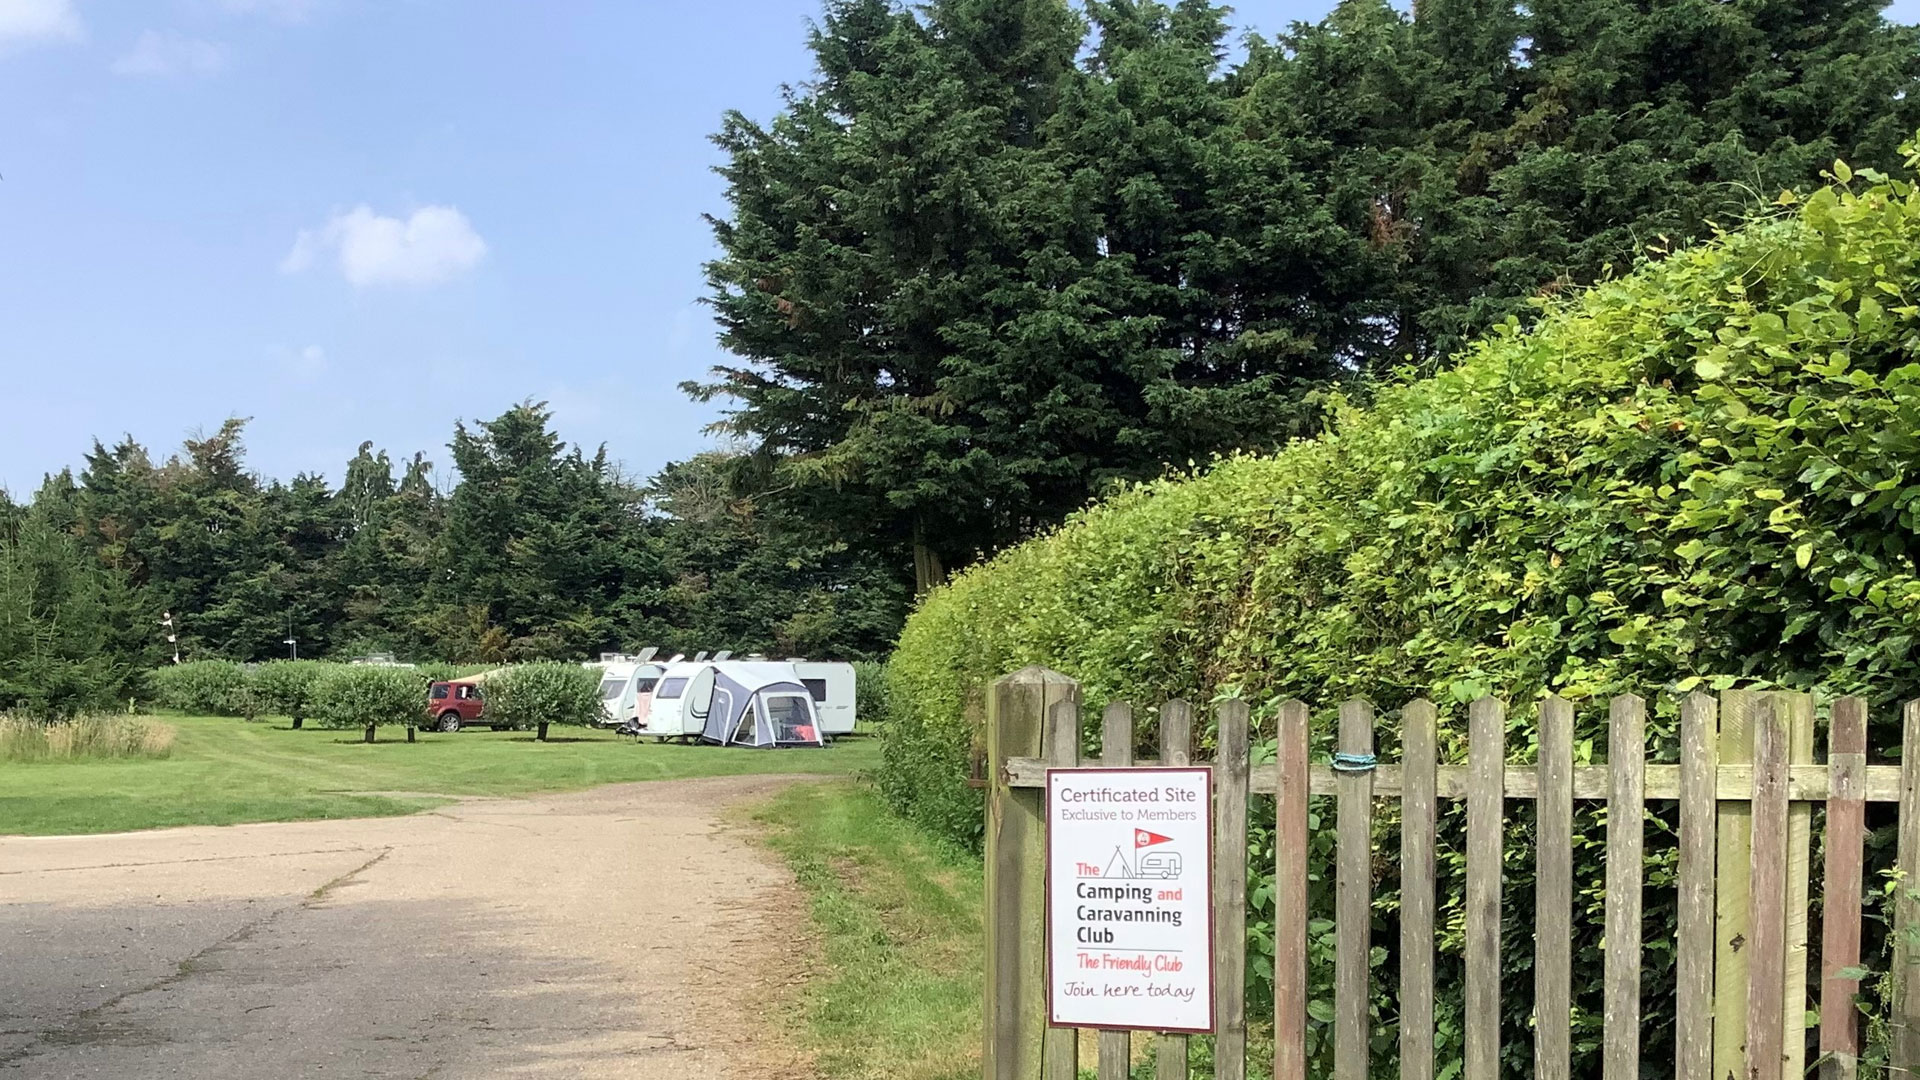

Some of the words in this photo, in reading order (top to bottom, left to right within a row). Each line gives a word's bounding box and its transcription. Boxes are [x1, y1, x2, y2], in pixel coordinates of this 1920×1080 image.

[1061, 788, 1159, 803] Certificated
[1166, 788, 1196, 802] Site
[1062, 809, 1117, 821] Exclusive
[1121, 810, 1133, 821] to
[1137, 809, 1196, 821] Members
[1076, 863, 1100, 876] The
[1077, 883, 1153, 903] Camping
[1157, 888, 1182, 900] and
[1077, 905, 1182, 926] Caravanning
[1077, 927, 1114, 943] Club
[1077, 953, 1099, 969] The
[1103, 954, 1152, 977] Friendly
[1155, 955, 1183, 972] Club
[1064, 982, 1098, 997] Join
[1104, 983, 1142, 997] here
[1147, 984, 1195, 1002] today
